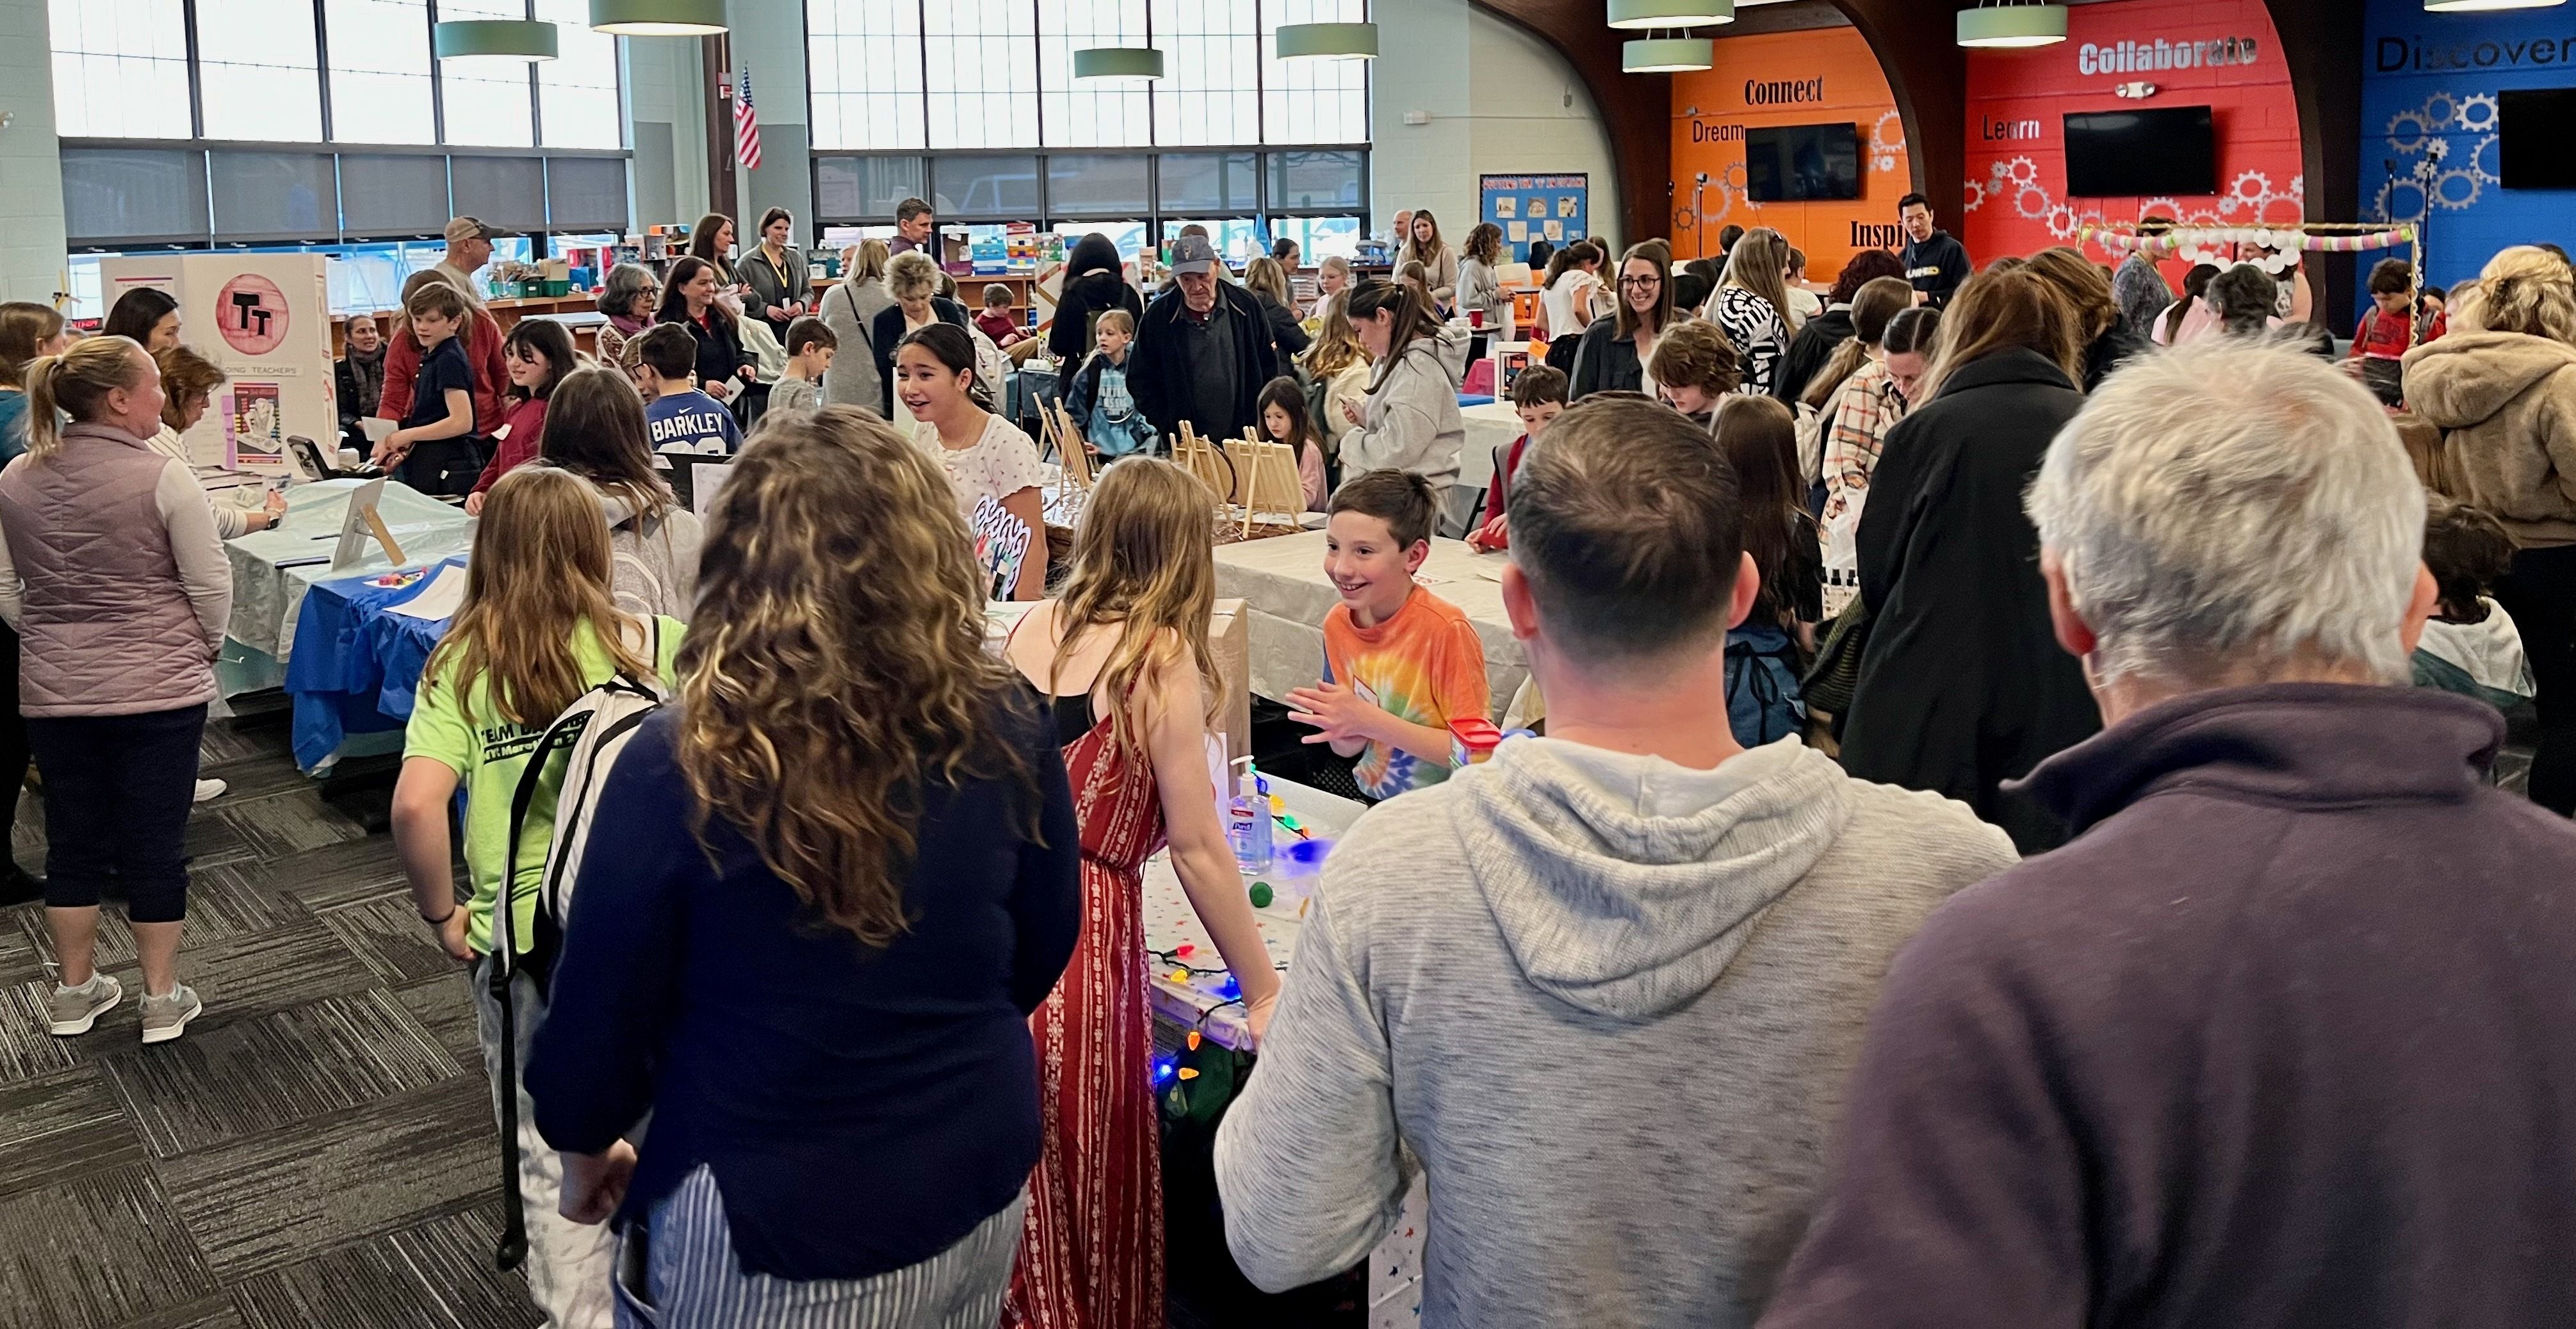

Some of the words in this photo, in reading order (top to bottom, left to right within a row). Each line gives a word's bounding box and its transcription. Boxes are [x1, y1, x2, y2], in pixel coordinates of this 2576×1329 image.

[2079, 36, 2257, 76] Collaborate
[2377, 34, 2576, 72] Discover
[1745, 74, 1823, 106] Connect
[1693, 120, 1744, 143] Dream
[1983, 113, 2040, 140] Learn
[1850, 220, 1910, 250] Inspi
[251, 366, 297, 375] TEACHERS
[651, 412, 722, 442] BARKLEY
